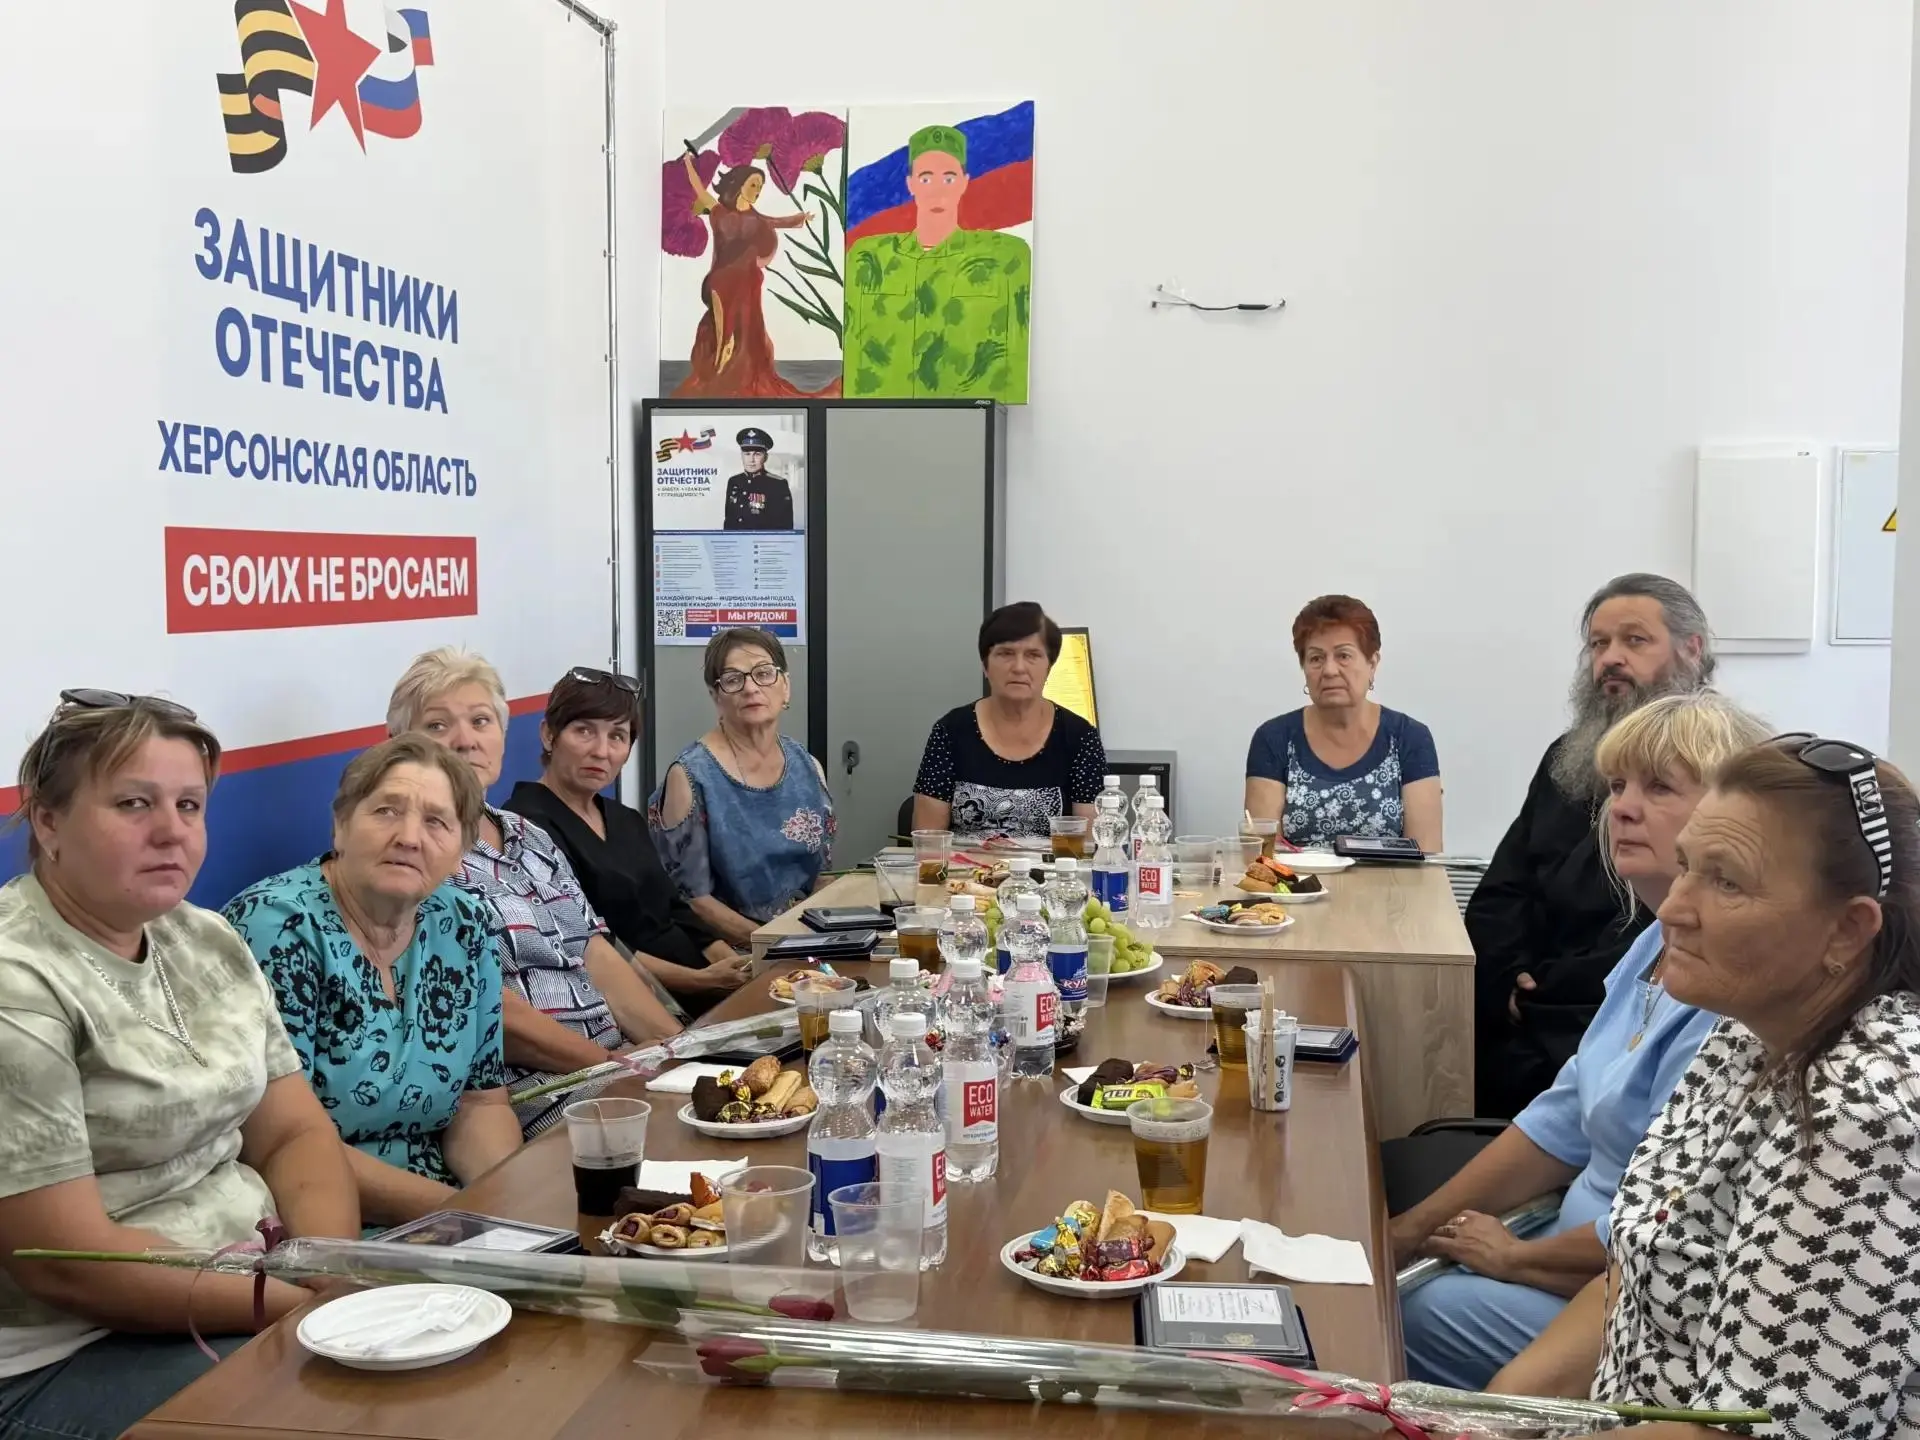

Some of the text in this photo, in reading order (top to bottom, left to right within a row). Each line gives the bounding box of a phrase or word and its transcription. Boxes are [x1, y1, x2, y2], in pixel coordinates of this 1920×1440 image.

[193, 207, 459, 344] ЗАЩИТНИКИ
[215, 306, 449, 414] ОТЕЧЕСТВА
[156, 419, 477, 497] ХЕРСОНСКАЯ ОБЛАСТЬ
[657, 468, 718, 476] ЗАЩИТНИКИ
[657, 477, 711, 485] ОТЕЧЕСТВА
[182, 554, 469, 607] СВОИХ НЕ БРОСАЕМ
[728, 611, 788, 621] МЫ РЯДОМ!
[1140, 868, 1157, 881] ECO
[969, 1083, 993, 1105] ECO
[970, 1104, 993, 1117] WATER
